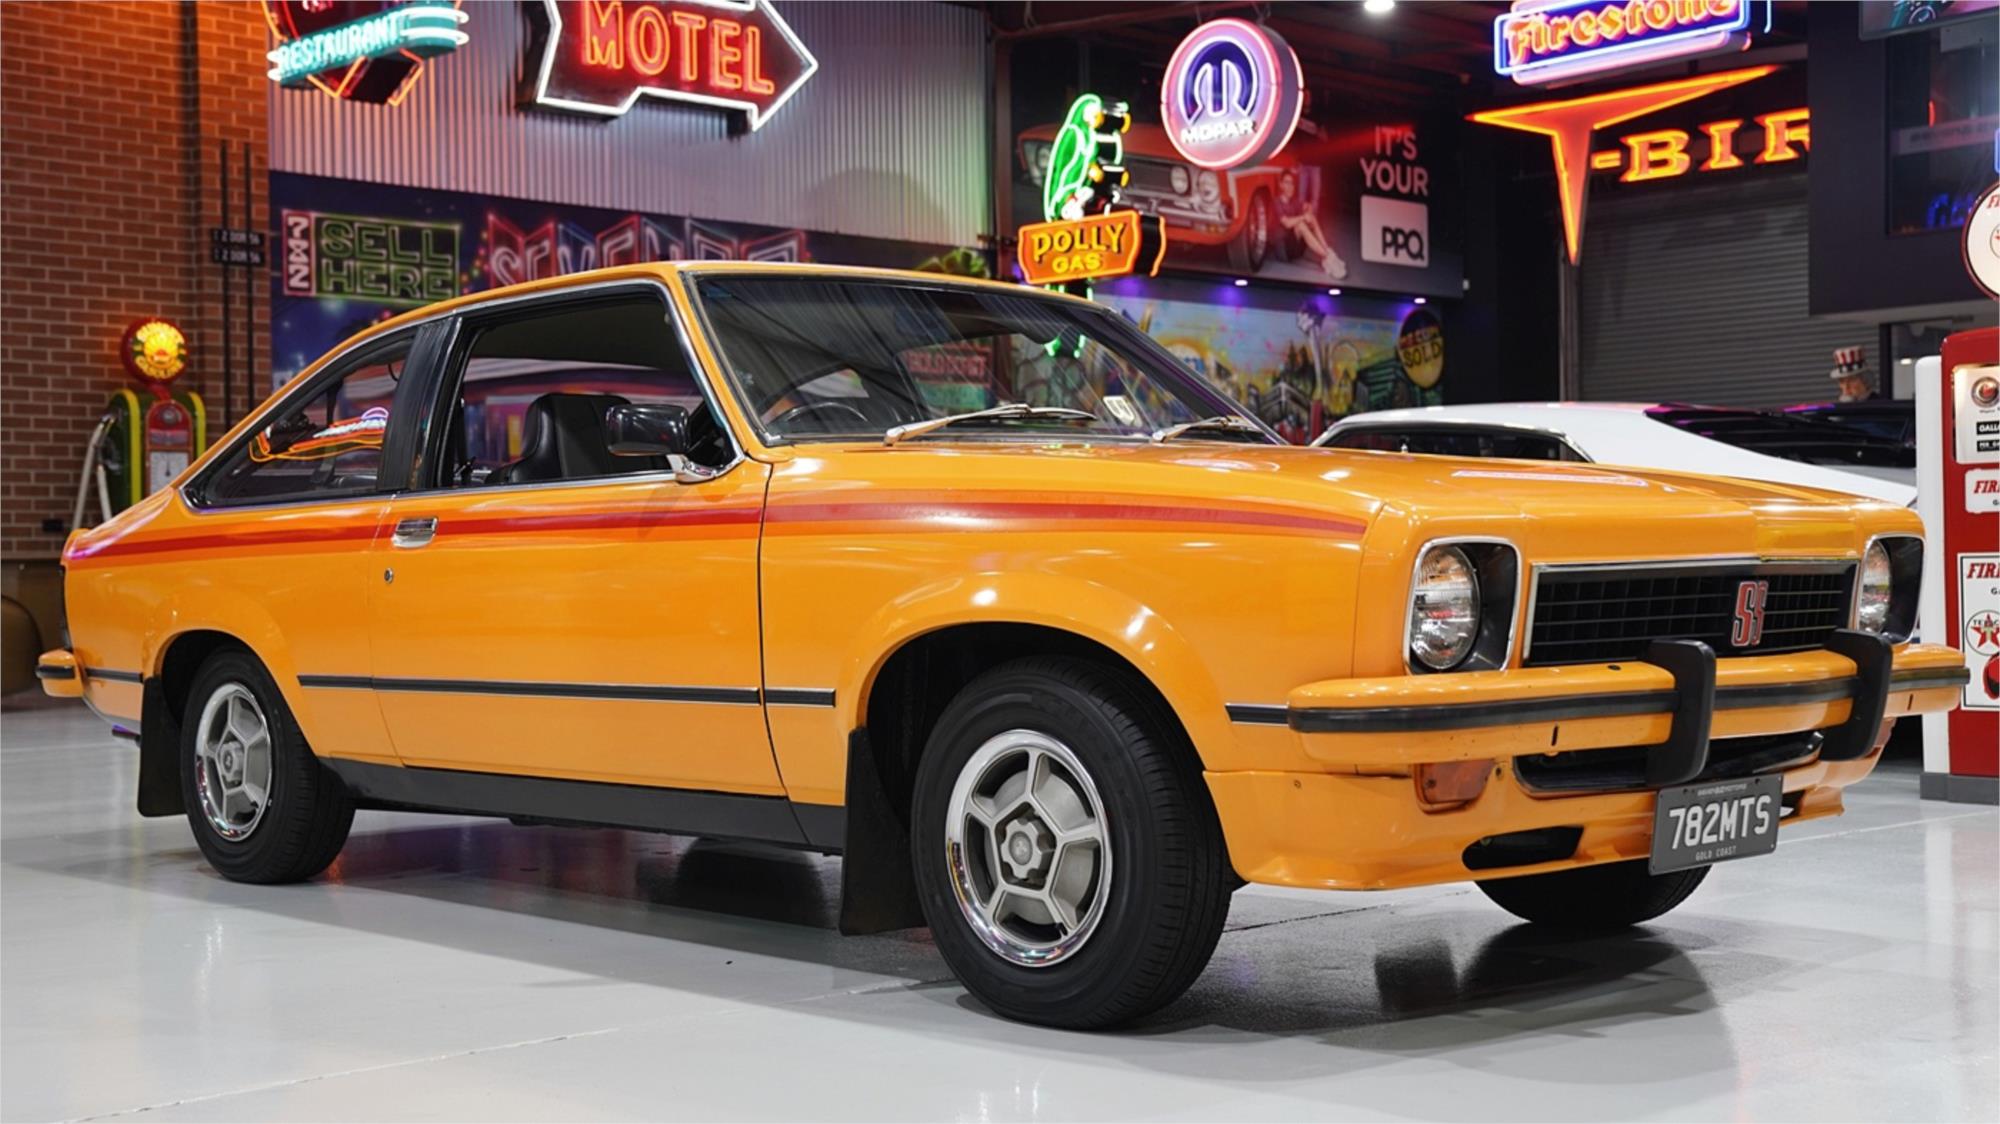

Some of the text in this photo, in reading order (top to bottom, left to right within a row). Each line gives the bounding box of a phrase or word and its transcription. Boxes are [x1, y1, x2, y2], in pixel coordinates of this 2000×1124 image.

[279, 11, 404, 71] RESTAURANT
[583, 1, 774, 95] MOTEL
[1181, 119, 1257, 143] MOPAR
[1375, 126, 1417, 160] IT'S
[1360, 158, 1428, 196] YOUR
[321, 220, 452, 266] SELL
[1031, 222, 1125, 263] POLLY
[1382, 226, 1425, 261] PPQ
[321, 258, 452, 299] HERE
[1052, 252, 1101, 274] GAS
[1979, 424, 1999, 432] GALL
[1974, 480, 1999, 494] FIR
[1731, 581, 1769, 646] SS
[1669, 795, 1772, 850] 782MTS
[1695, 845, 1737, 861] GOLD COAST
